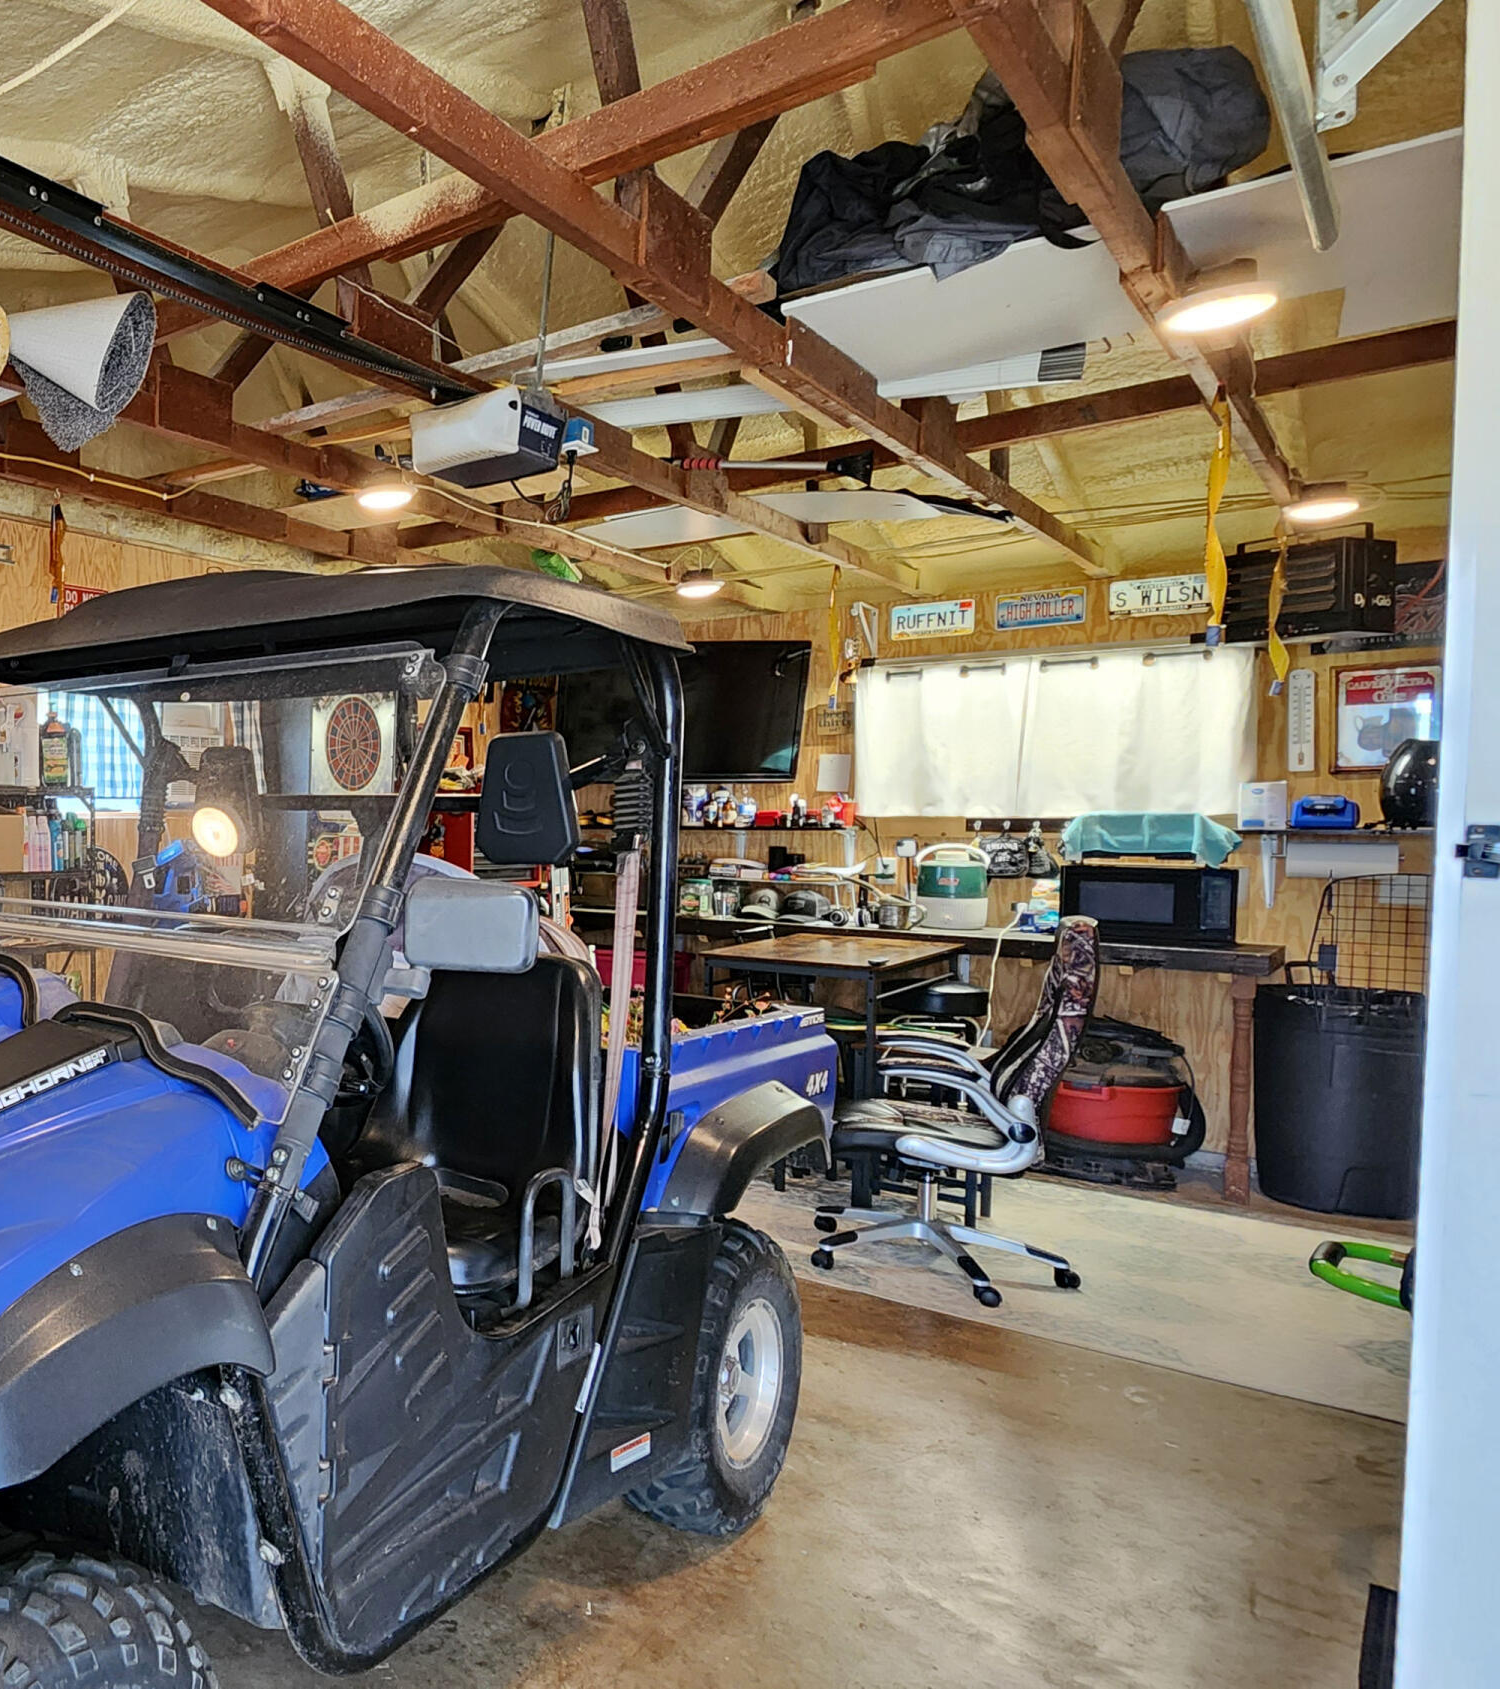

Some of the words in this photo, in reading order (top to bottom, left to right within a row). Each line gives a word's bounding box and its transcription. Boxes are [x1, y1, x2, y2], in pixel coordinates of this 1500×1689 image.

[1020, 591, 1061, 603] NEVADA
[1141, 584, 1204, 606] WILSN
[896, 609, 968, 631] RUFFNIT
[1006, 603, 1030, 620] HIGH
[1035, 599, 1075, 617] ROLLER
[806, 1070, 829, 1097] 4X4
